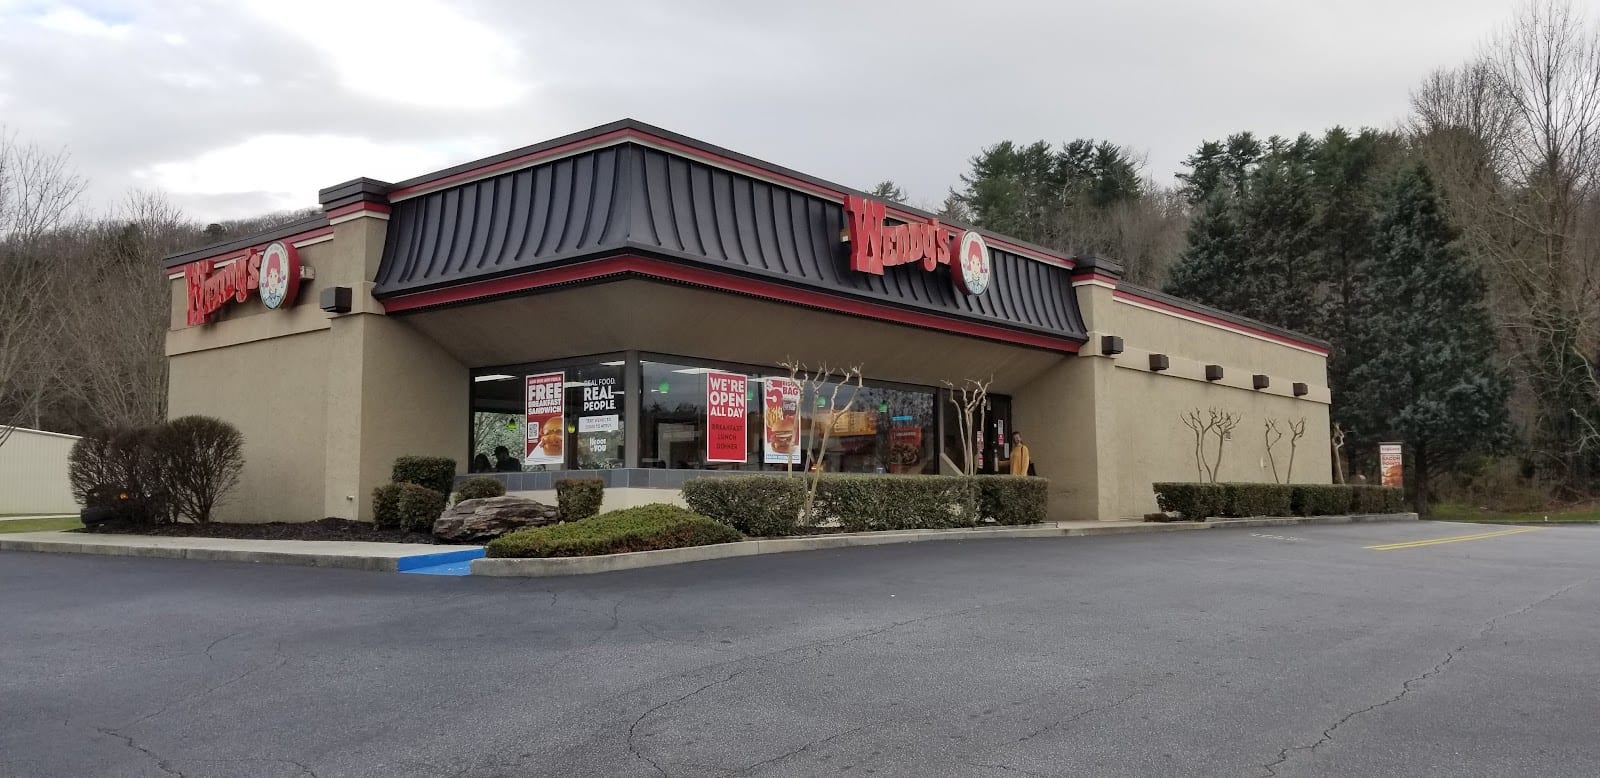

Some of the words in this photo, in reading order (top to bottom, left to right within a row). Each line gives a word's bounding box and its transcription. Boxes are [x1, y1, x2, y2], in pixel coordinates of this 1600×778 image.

[583, 379, 598, 387] REAL
[710, 377, 745, 393] WE'RE
[528, 382, 562, 402] FREE
[583, 385, 614, 401] REAL
[782, 386, 799, 396] BAG
[528, 399, 561, 408] BREAKFAST
[710, 391, 745, 408] OPEN
[528, 406, 562, 415] SANDWICH
[583, 400, 617, 411] PEOPLE.
[710, 406, 727, 417] ALL
[727, 407, 745, 418] DAY
[711, 423, 744, 431] BREAKFAST
